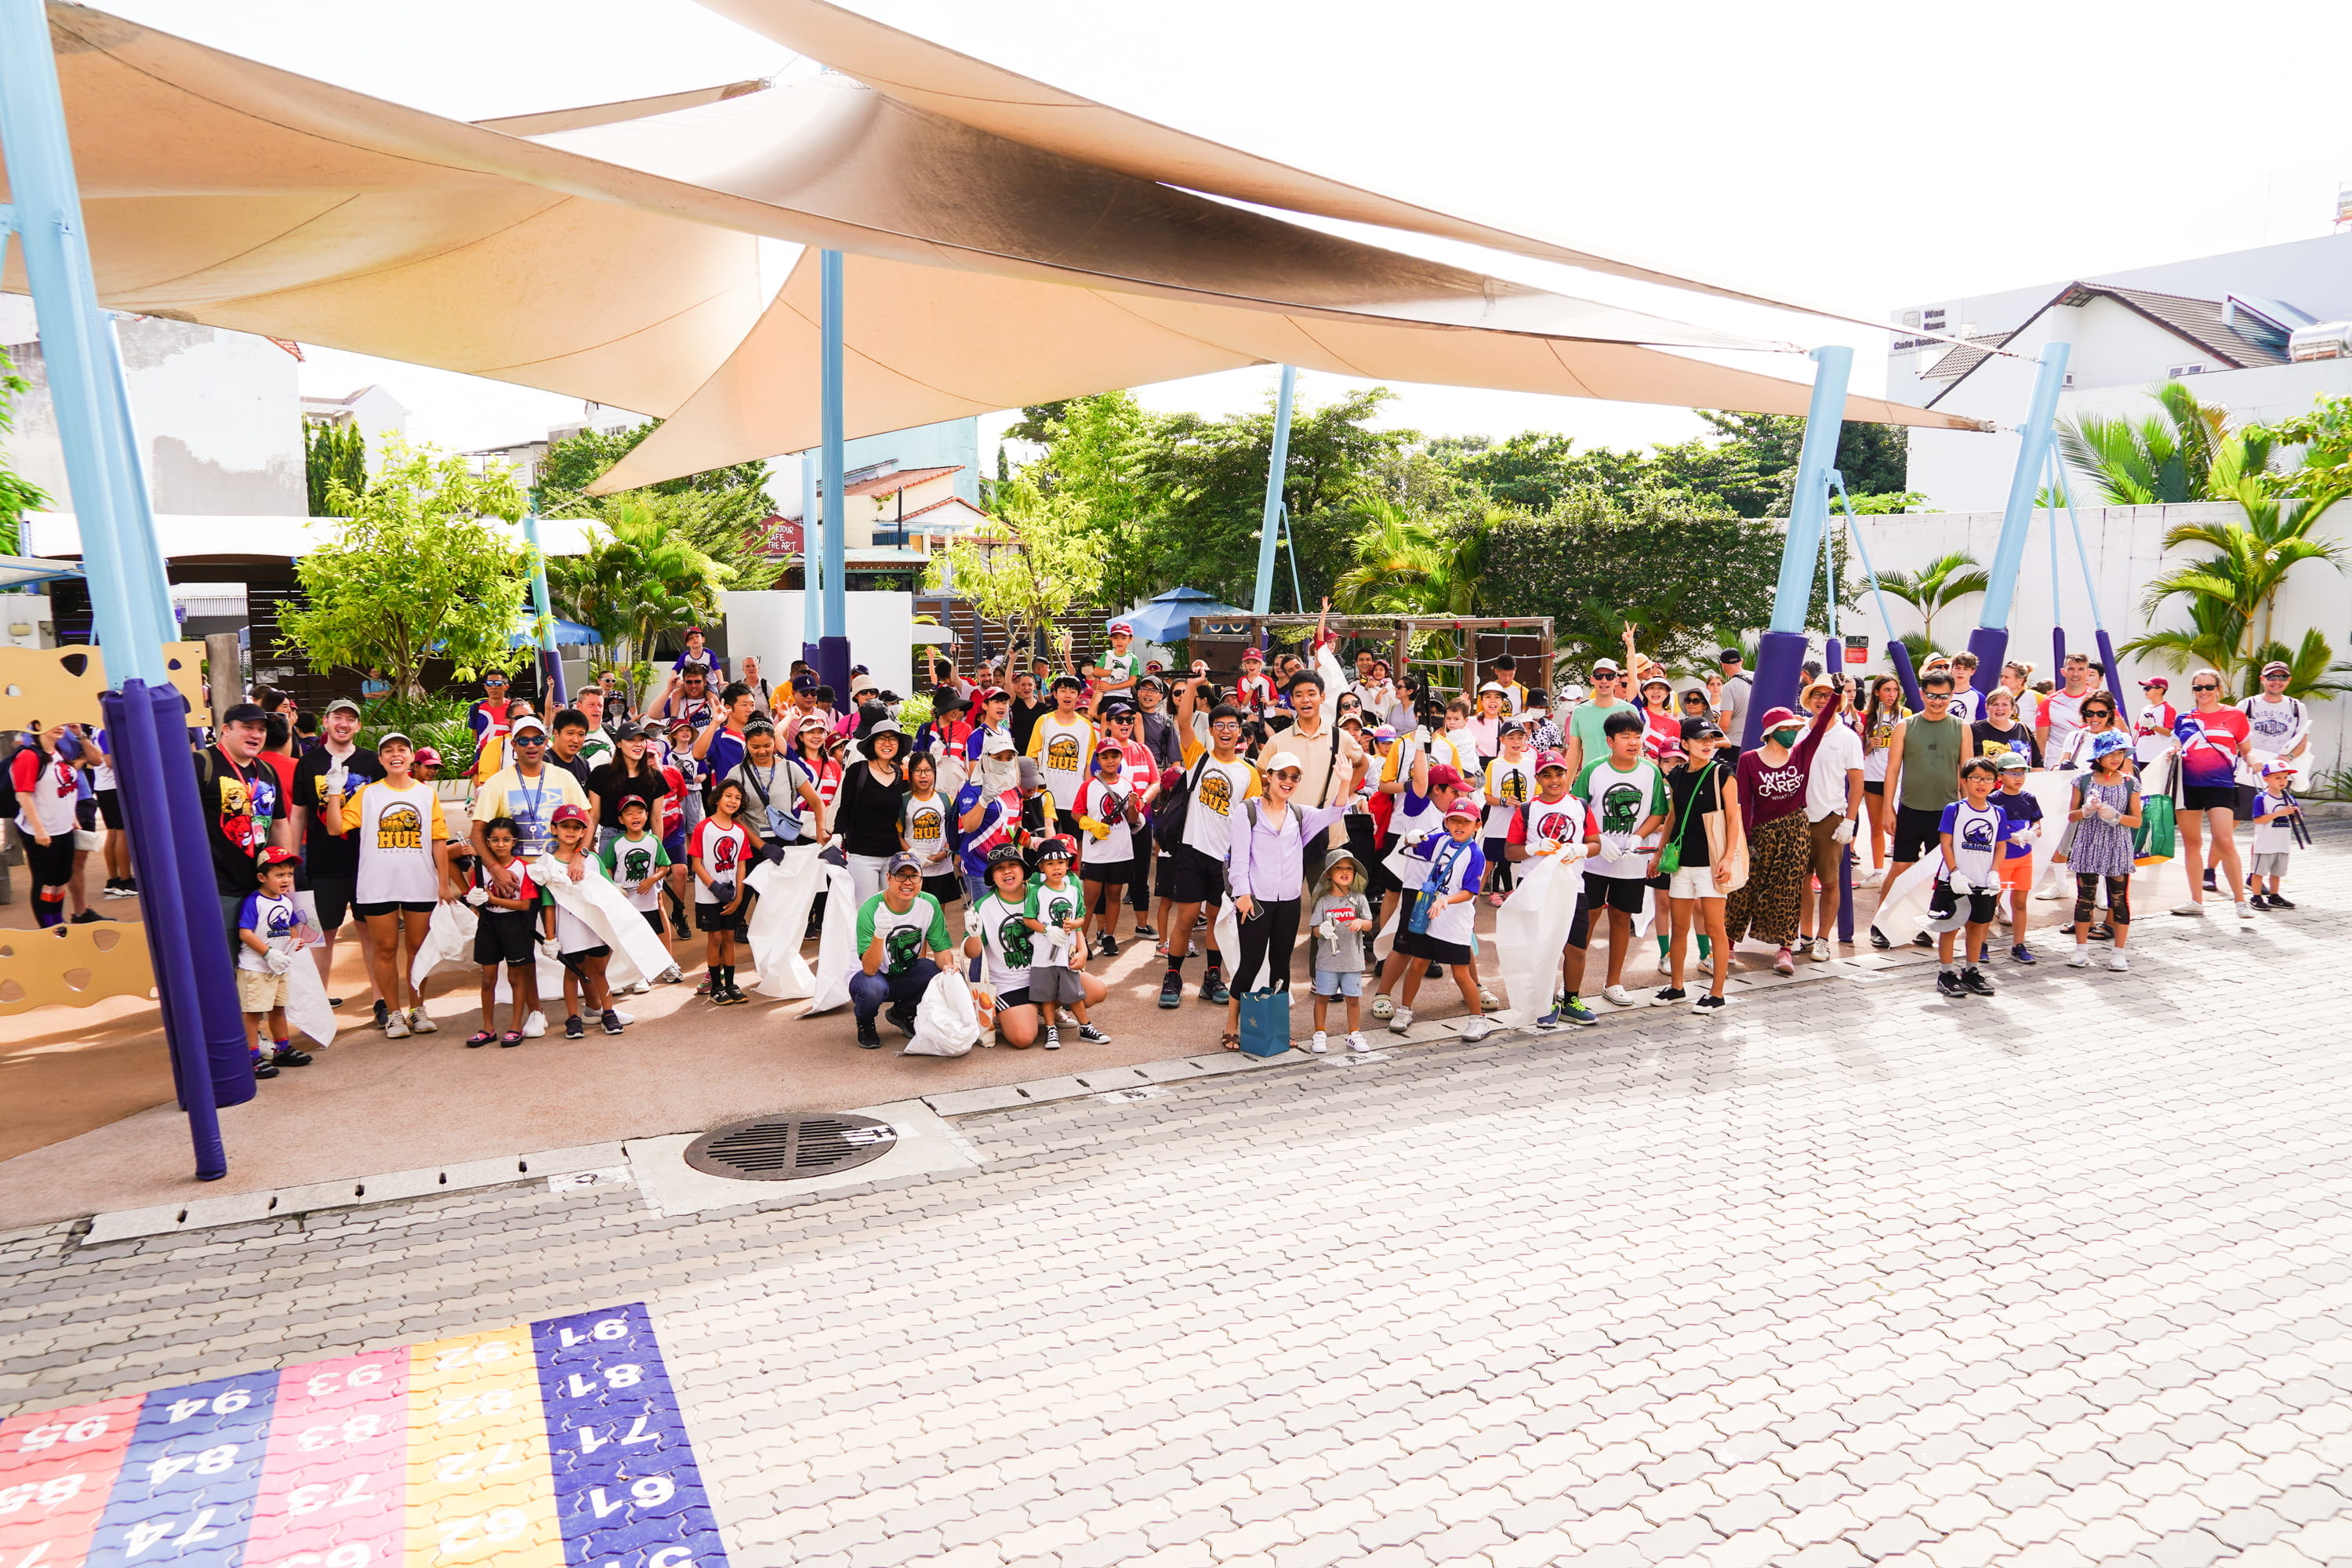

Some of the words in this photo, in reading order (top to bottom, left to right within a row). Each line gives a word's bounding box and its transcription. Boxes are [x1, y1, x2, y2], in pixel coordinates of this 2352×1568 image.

[1924, 321, 1945, 330] Haus
[1894, 340, 1913, 350] Cafe
[782, 542, 797, 553] ART
[1047, 753, 1079, 772] HUE
[1758, 766, 1798, 783] WHO
[1199, 786, 1230, 817] HUE
[377, 830, 423, 848] HUE
[913, 826, 941, 840] HUE
[1962, 841, 1992, 853] SAIGON
[560, 1319, 628, 1348] 91
[434, 1341, 510, 1371] 92
[307, 1364, 383, 1396] 93
[568, 1363, 642, 1398] 81
[165, 1387, 251, 1425] 94
[437, 1388, 514, 1424] 82
[17, 1414, 111, 1454] 95
[297, 1414, 382, 1452] 83
[579, 1416, 661, 1454] 71
[146, 1443, 239, 1485] 84
[436, 1443, 522, 1483] 72
[0, 1473, 87, 1515] 85
[286, 1474, 376, 1516] 73
[590, 1476, 675, 1519] 61
[123, 1508, 219, 1558] 74
[437, 1508, 528, 1554] 62
